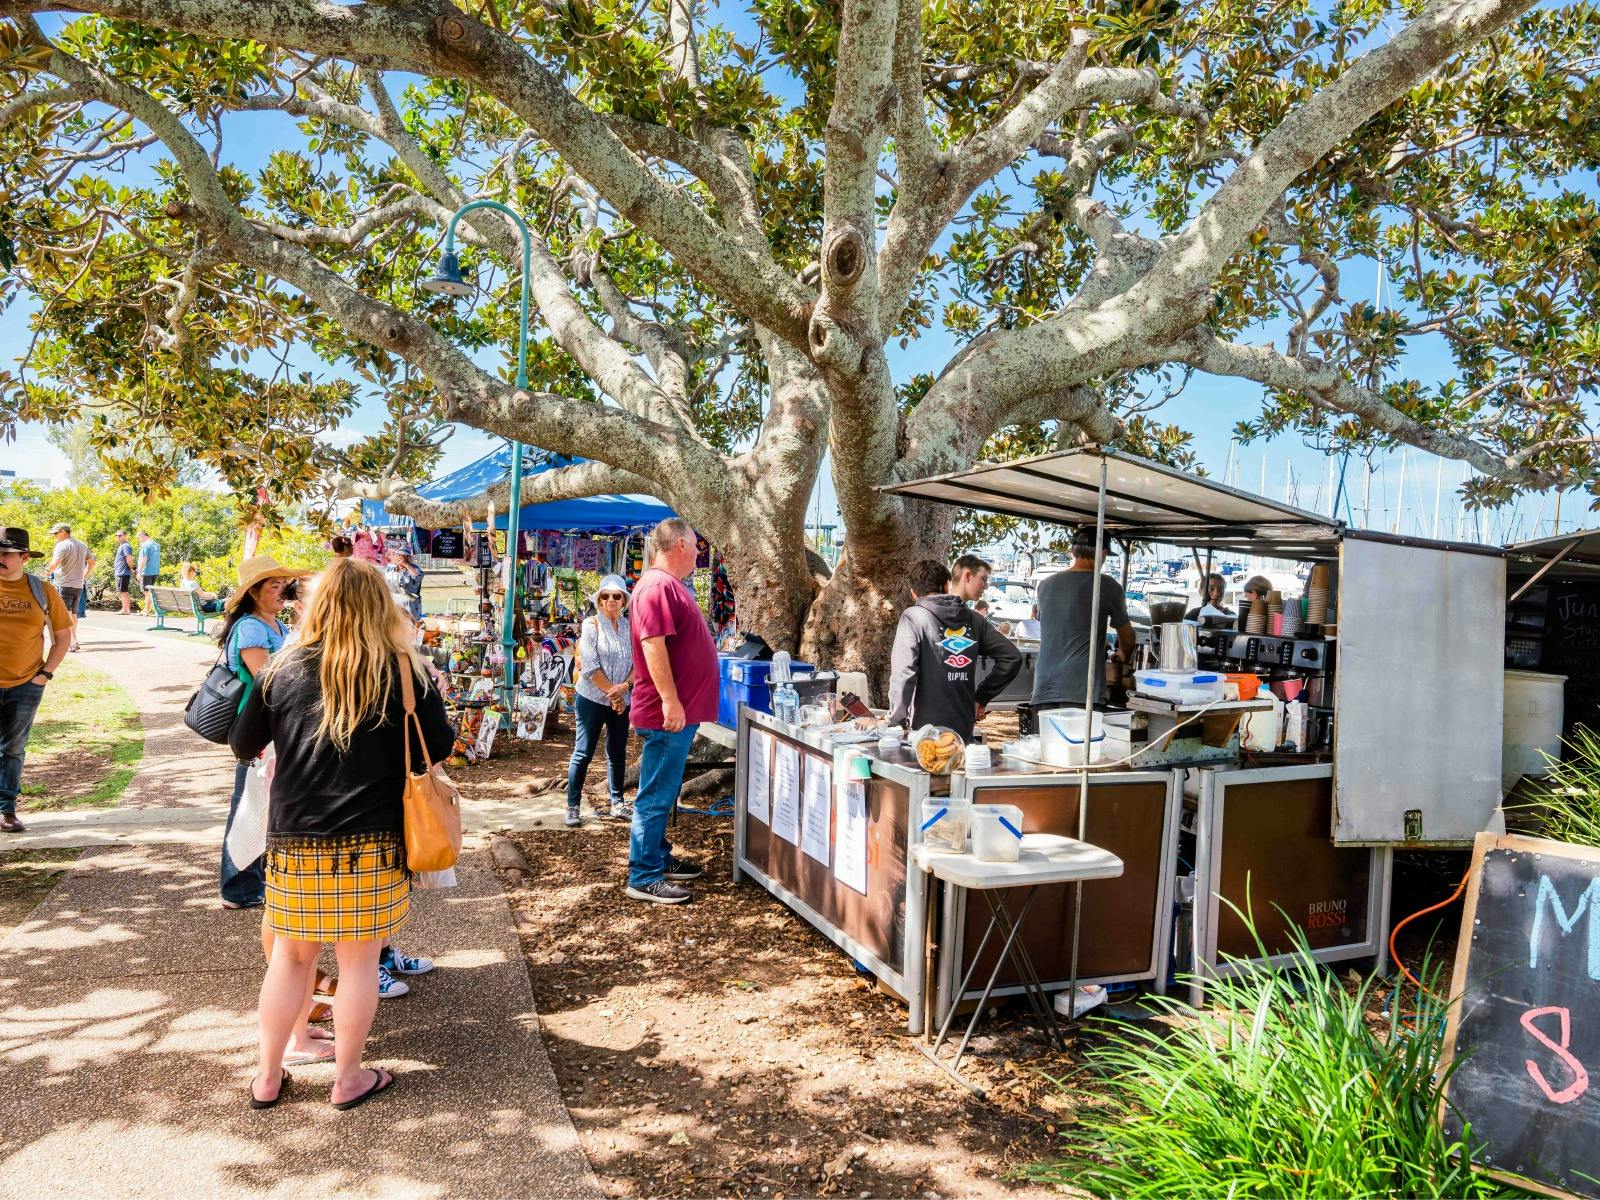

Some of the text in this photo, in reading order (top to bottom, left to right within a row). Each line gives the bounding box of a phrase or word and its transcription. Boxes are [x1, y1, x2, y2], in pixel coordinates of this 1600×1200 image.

[1308, 899, 1347, 915] BRUNO
[1530, 874, 1600, 981] M
[1519, 1005, 1589, 1104] S
